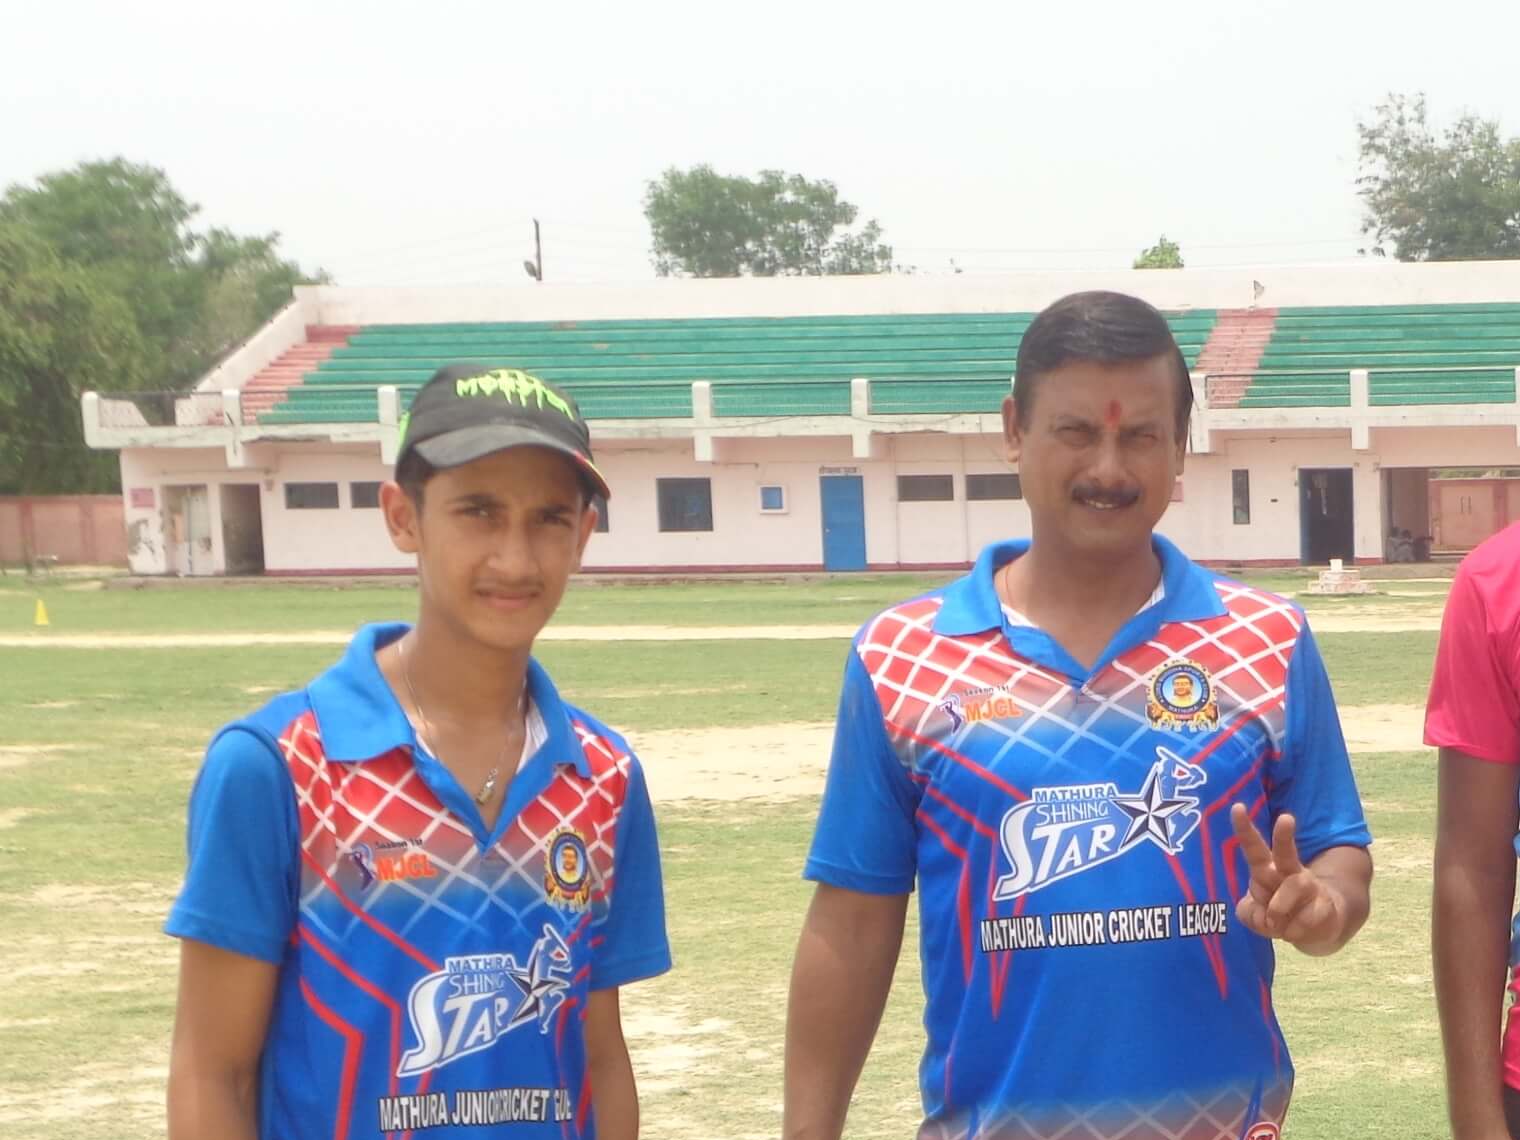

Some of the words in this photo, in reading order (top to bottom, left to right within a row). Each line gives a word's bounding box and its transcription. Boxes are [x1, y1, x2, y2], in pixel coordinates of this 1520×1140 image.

[963, 697, 1024, 723] MJCL
[1034, 784, 1117, 802] MATHURA
[1035, 800, 1109, 827] SHINING
[995, 803, 1117, 897] STAR
[376, 852, 438, 881] MJCL
[980, 914, 1047, 952] MATHURA
[1047, 912, 1105, 947] JUNIOR
[1107, 907, 1171, 943] CRICKET
[1178, 903, 1227, 936] LEAGUE
[380, 1093, 449, 1131] MATHURA
